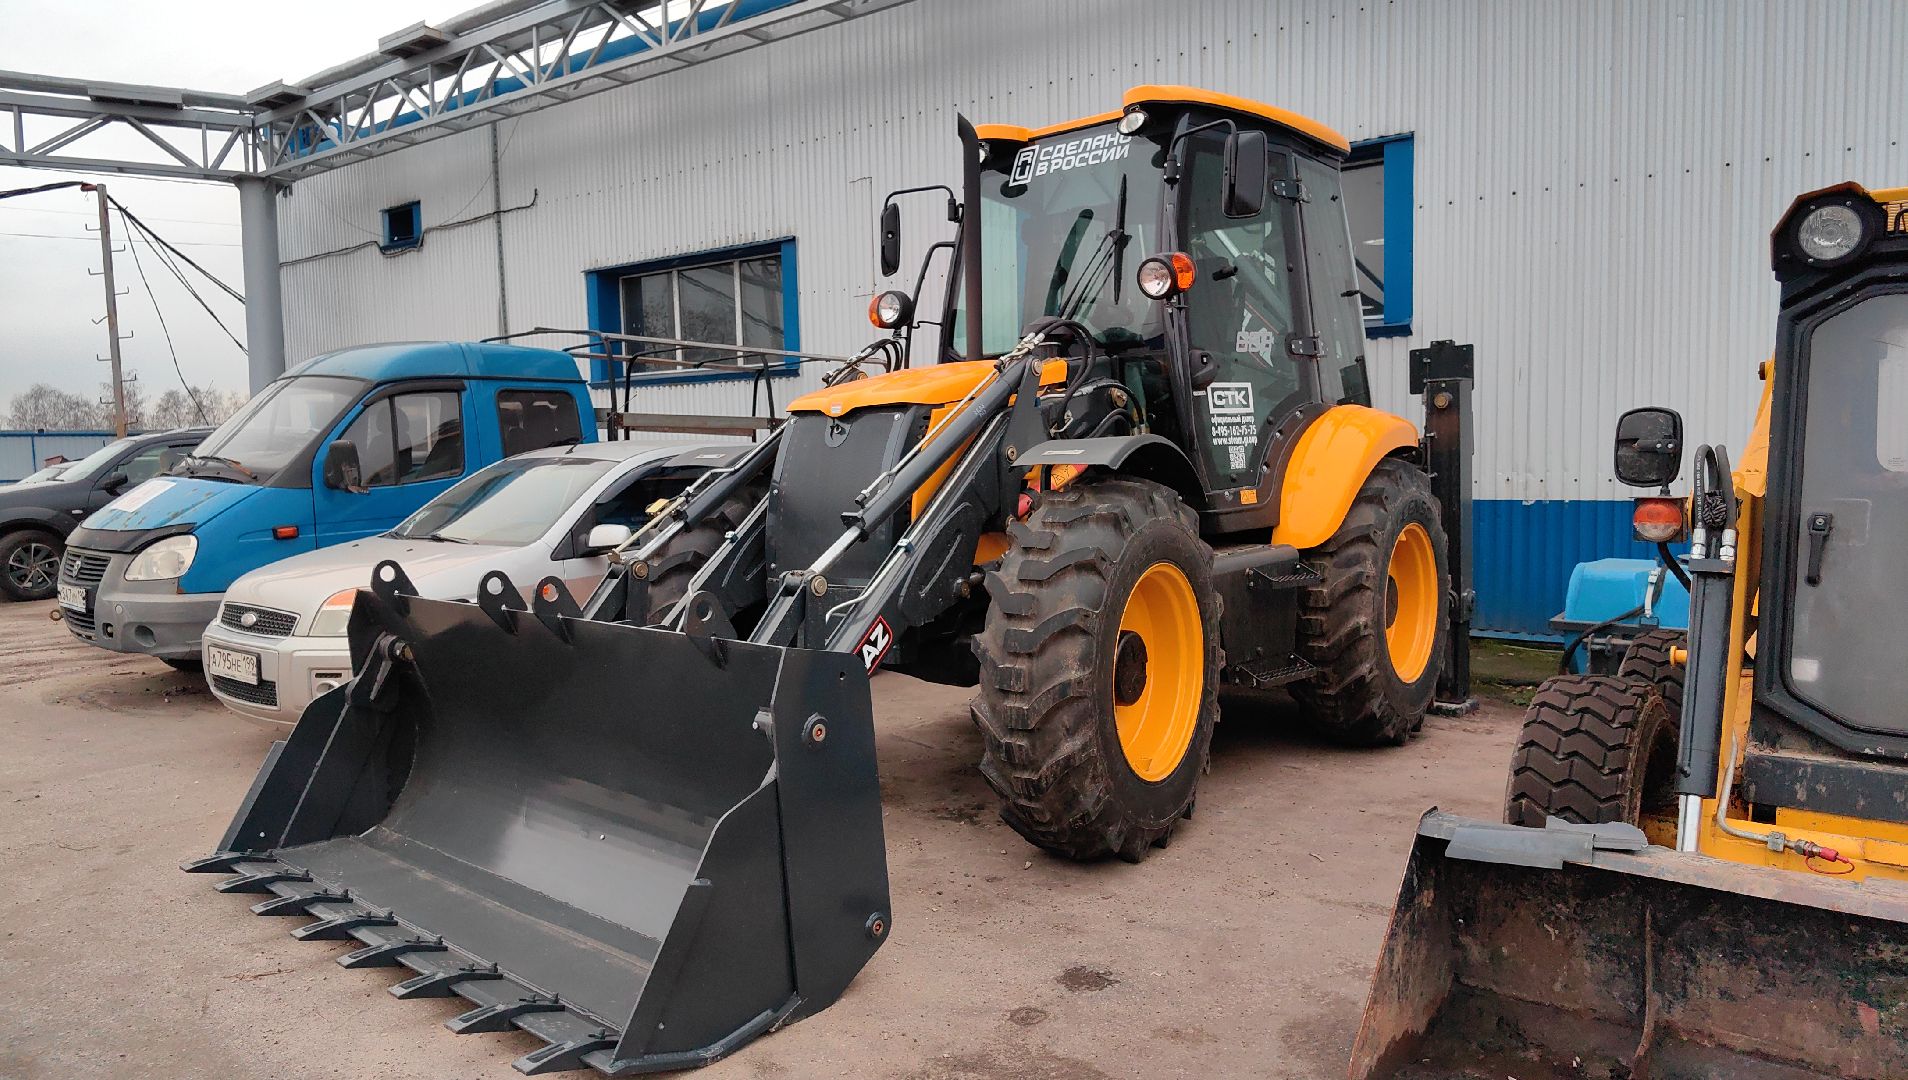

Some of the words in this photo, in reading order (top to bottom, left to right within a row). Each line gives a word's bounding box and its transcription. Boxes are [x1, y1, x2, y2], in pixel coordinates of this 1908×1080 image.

[1213, 390, 1247, 405] СТК
[863, 622, 890, 670] AZ
[211, 650, 242, 673] А795НЕ
